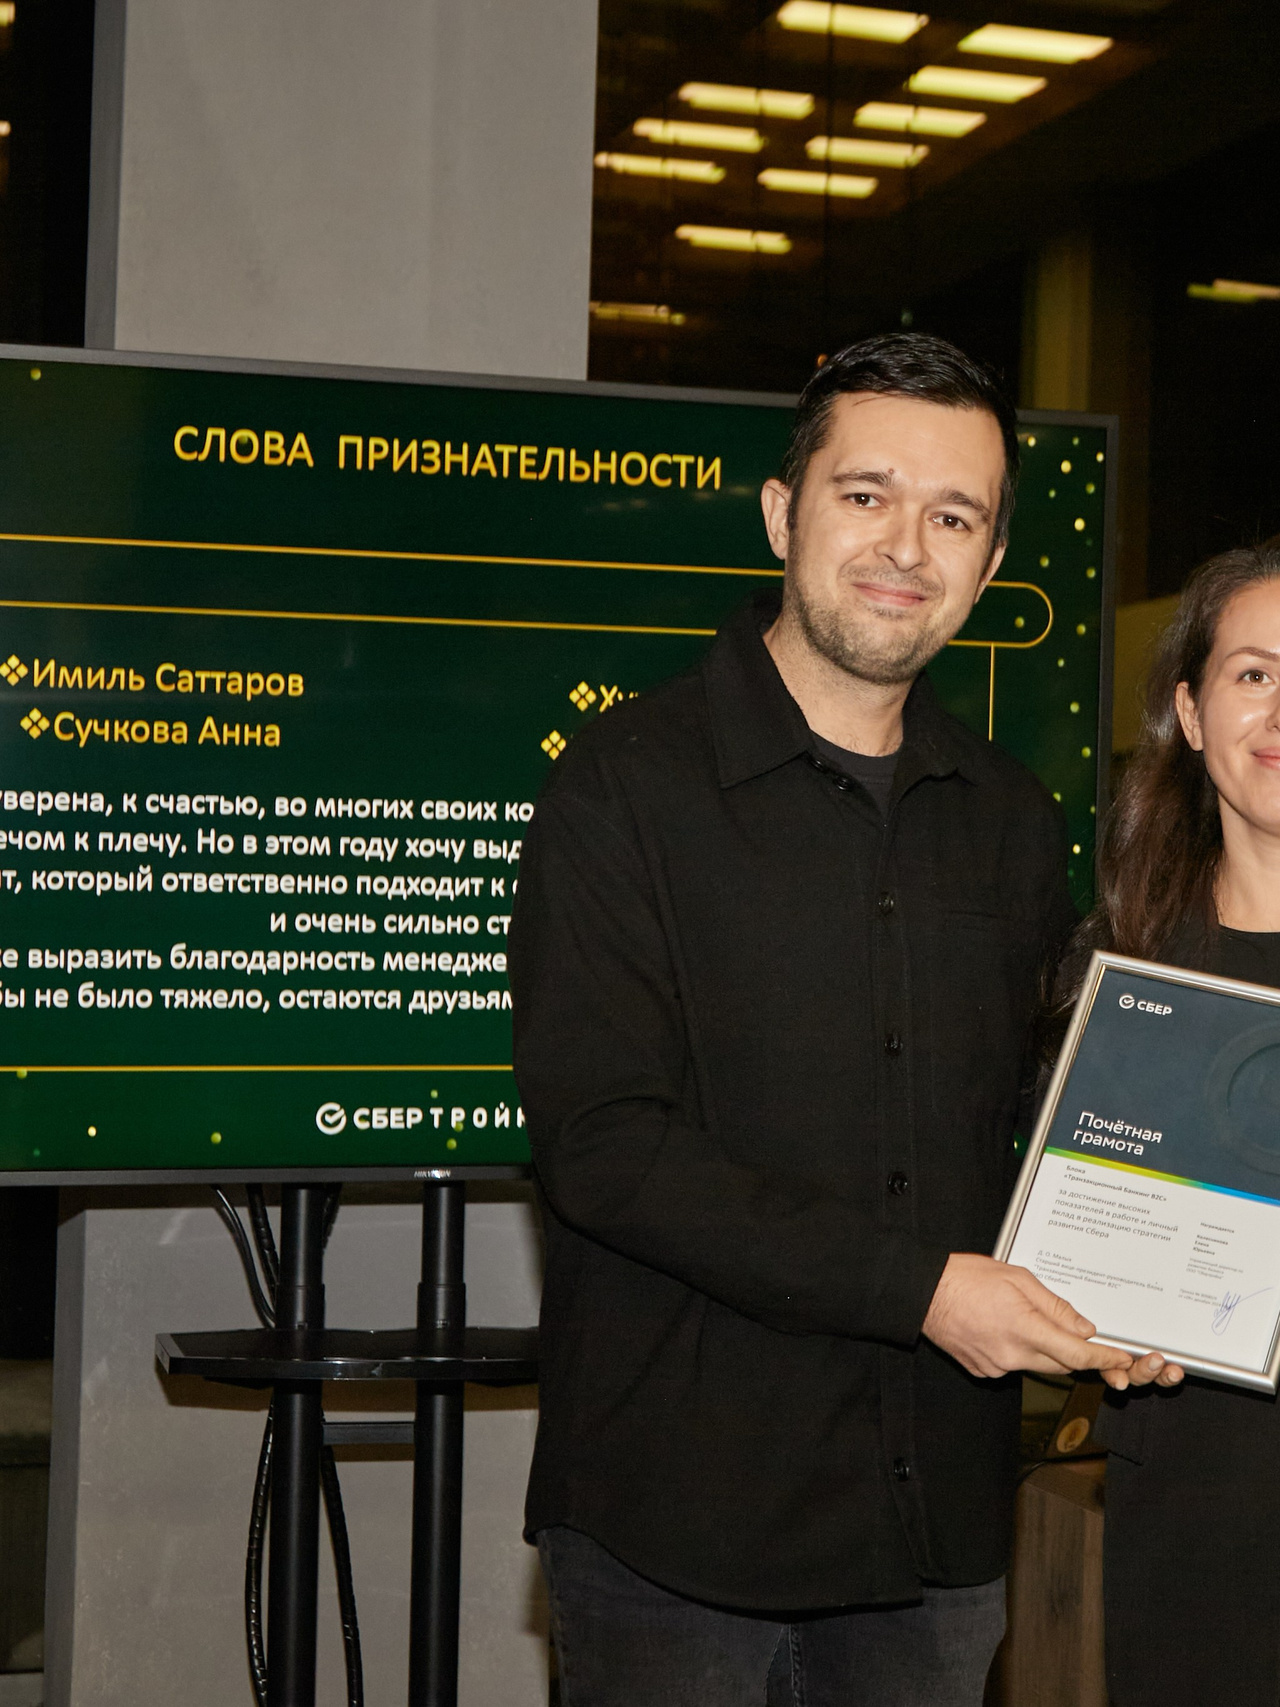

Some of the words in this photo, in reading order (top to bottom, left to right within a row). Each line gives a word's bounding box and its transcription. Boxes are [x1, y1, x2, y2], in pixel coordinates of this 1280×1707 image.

[174, 426, 314, 467] СЛОВА
[339, 435, 721, 490] ПРИЗНАТЕЛЬНОСТИ
[34, 659, 145, 691] Имиль
[156, 663, 304, 701] Саттаров
[54, 712, 188, 747] Сучкова
[198, 716, 280, 746] Анна
[0, 790, 112, 816] верена,
[123, 793, 137, 813] к
[146, 794, 265, 820] счастью,
[275, 797, 307, 816] во
[315, 798, 413, 819] многих
[421, 800, 497, 821] своих
[75, 832, 89, 851] к
[99, 832, 186, 858] плечу.
[198, 828, 234, 854] Но
[243, 835, 257, 854] в
[266, 835, 331, 856] этом
[340, 837, 398, 862] году
[405, 838, 465, 863] хочу
[0, 870, 21, 894] т,
[32, 865, 152, 896] который
[162, 873, 348, 894] ответственно
[357, 876, 484, 901] подходит
[491, 878, 504, 897] к
[271, 913, 286, 932] и
[295, 913, 376, 933] очень
[384, 914, 479, 934] сильно
[28, 949, 161, 974] выразить
[170, 943, 375, 975] благодарность
[35, 989, 69, 1008] не
[78, 981, 153, 1008] было
[160, 989, 270, 1013] тяжело,
[279, 990, 401, 1009] остаются
[1136, 1000, 1172, 1016] СБЕР
[1072, 1130, 1144, 1156] грамота
[1078, 1111, 1162, 1144] Почётная
[1066, 1165, 1086, 1174] Блока
[1068, 1190, 1116, 1208] достижение
[1118, 1203, 1151, 1216] высоких
[1123, 1187, 1150, 1198] Банкинг
[1048, 1219, 1084, 1232] развития
[1085, 1227, 1110, 1239] Сбера
[1052, 1209, 1074, 1220] вклад
[1082, 1216, 1132, 1233] реализацию
[1132, 1228, 1172, 1242] стратегии
[1054, 1198, 1104, 1216] показателей
[1112, 1210, 1140, 1224] работе
[1148, 1220, 1178, 1233] личный
